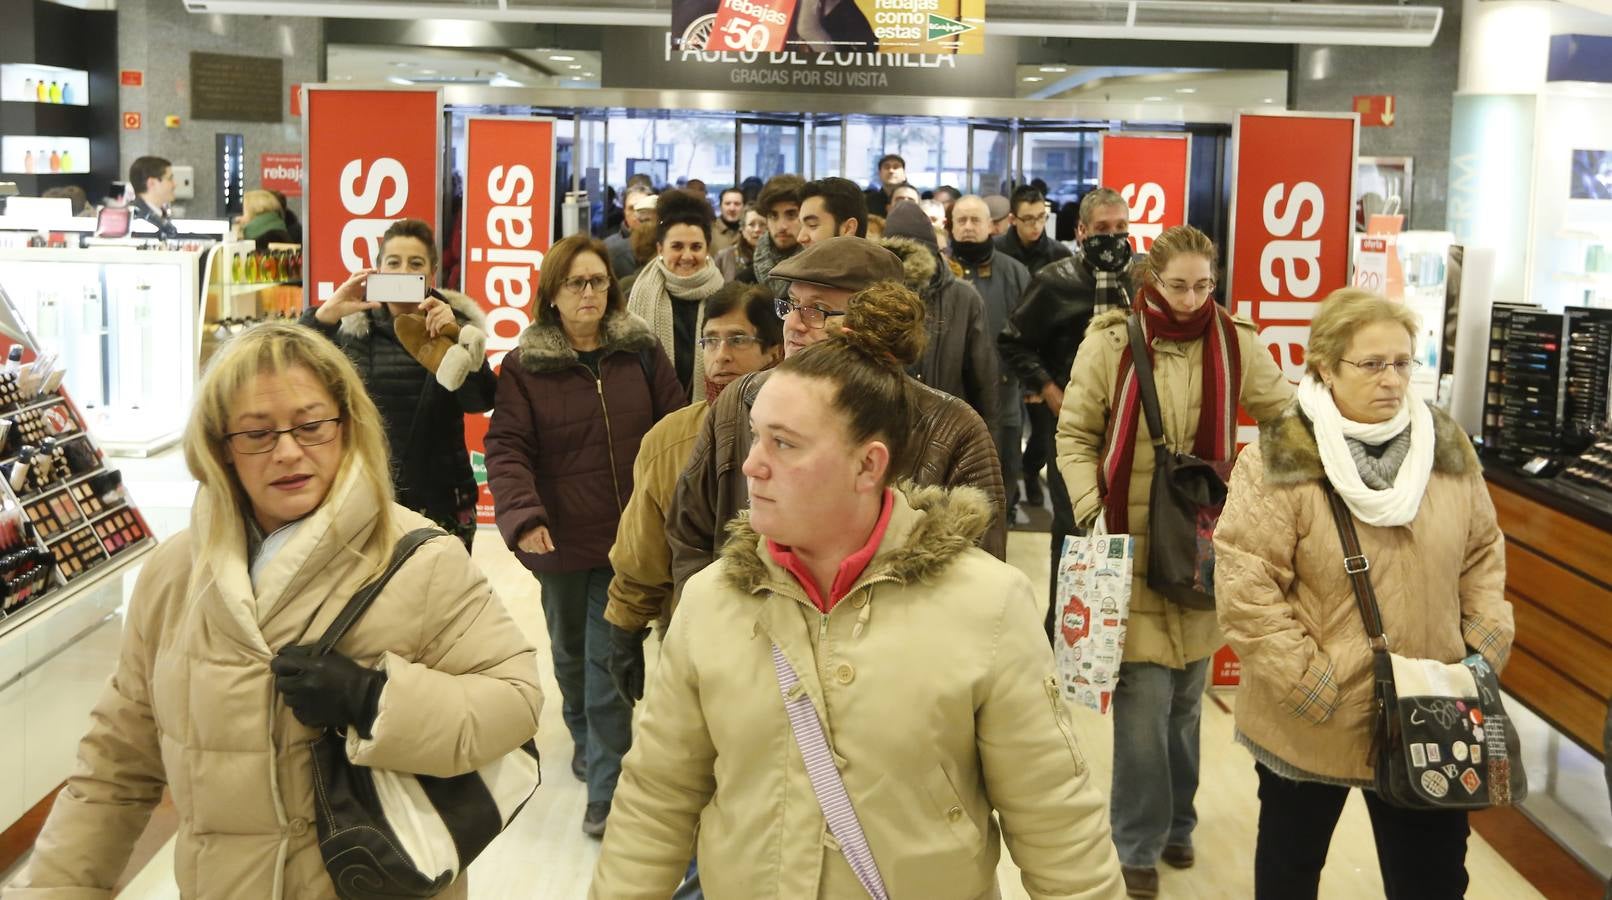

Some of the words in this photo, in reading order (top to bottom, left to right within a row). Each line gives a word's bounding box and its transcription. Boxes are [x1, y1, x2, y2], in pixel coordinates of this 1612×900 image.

[724, 0, 787, 25] rebajas
[875, 11, 925, 24] como
[874, 24, 921, 39] estas
[731, 68, 788, 85] GRACIAS
[792, 70, 821, 86] POR
[823, 71, 843, 87] SU
[846, 71, 889, 88] VISITA
[471, 164, 544, 418] bajas
